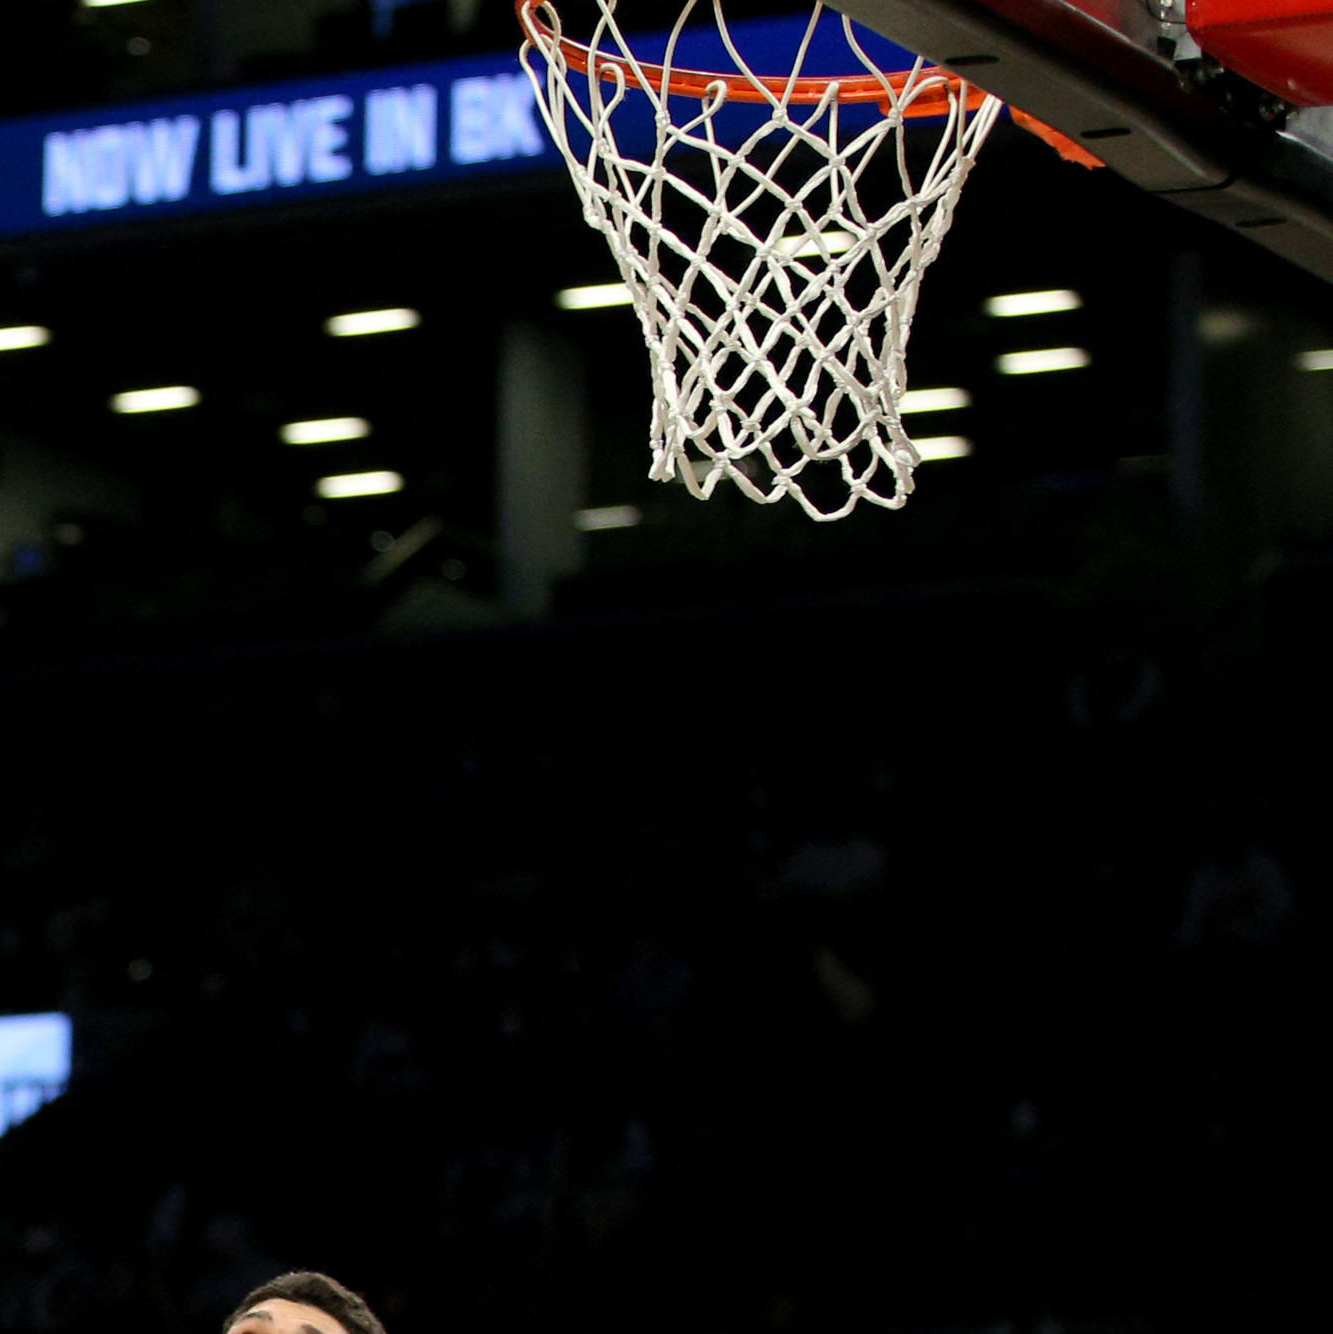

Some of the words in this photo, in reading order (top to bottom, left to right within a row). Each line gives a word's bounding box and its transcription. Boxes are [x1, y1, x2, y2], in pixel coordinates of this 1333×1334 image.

[42, 114, 199, 218] NOW
[209, 94, 353, 196] LIVE
[364, 83, 437, 176] IN
[450, 71, 544, 166] BK
